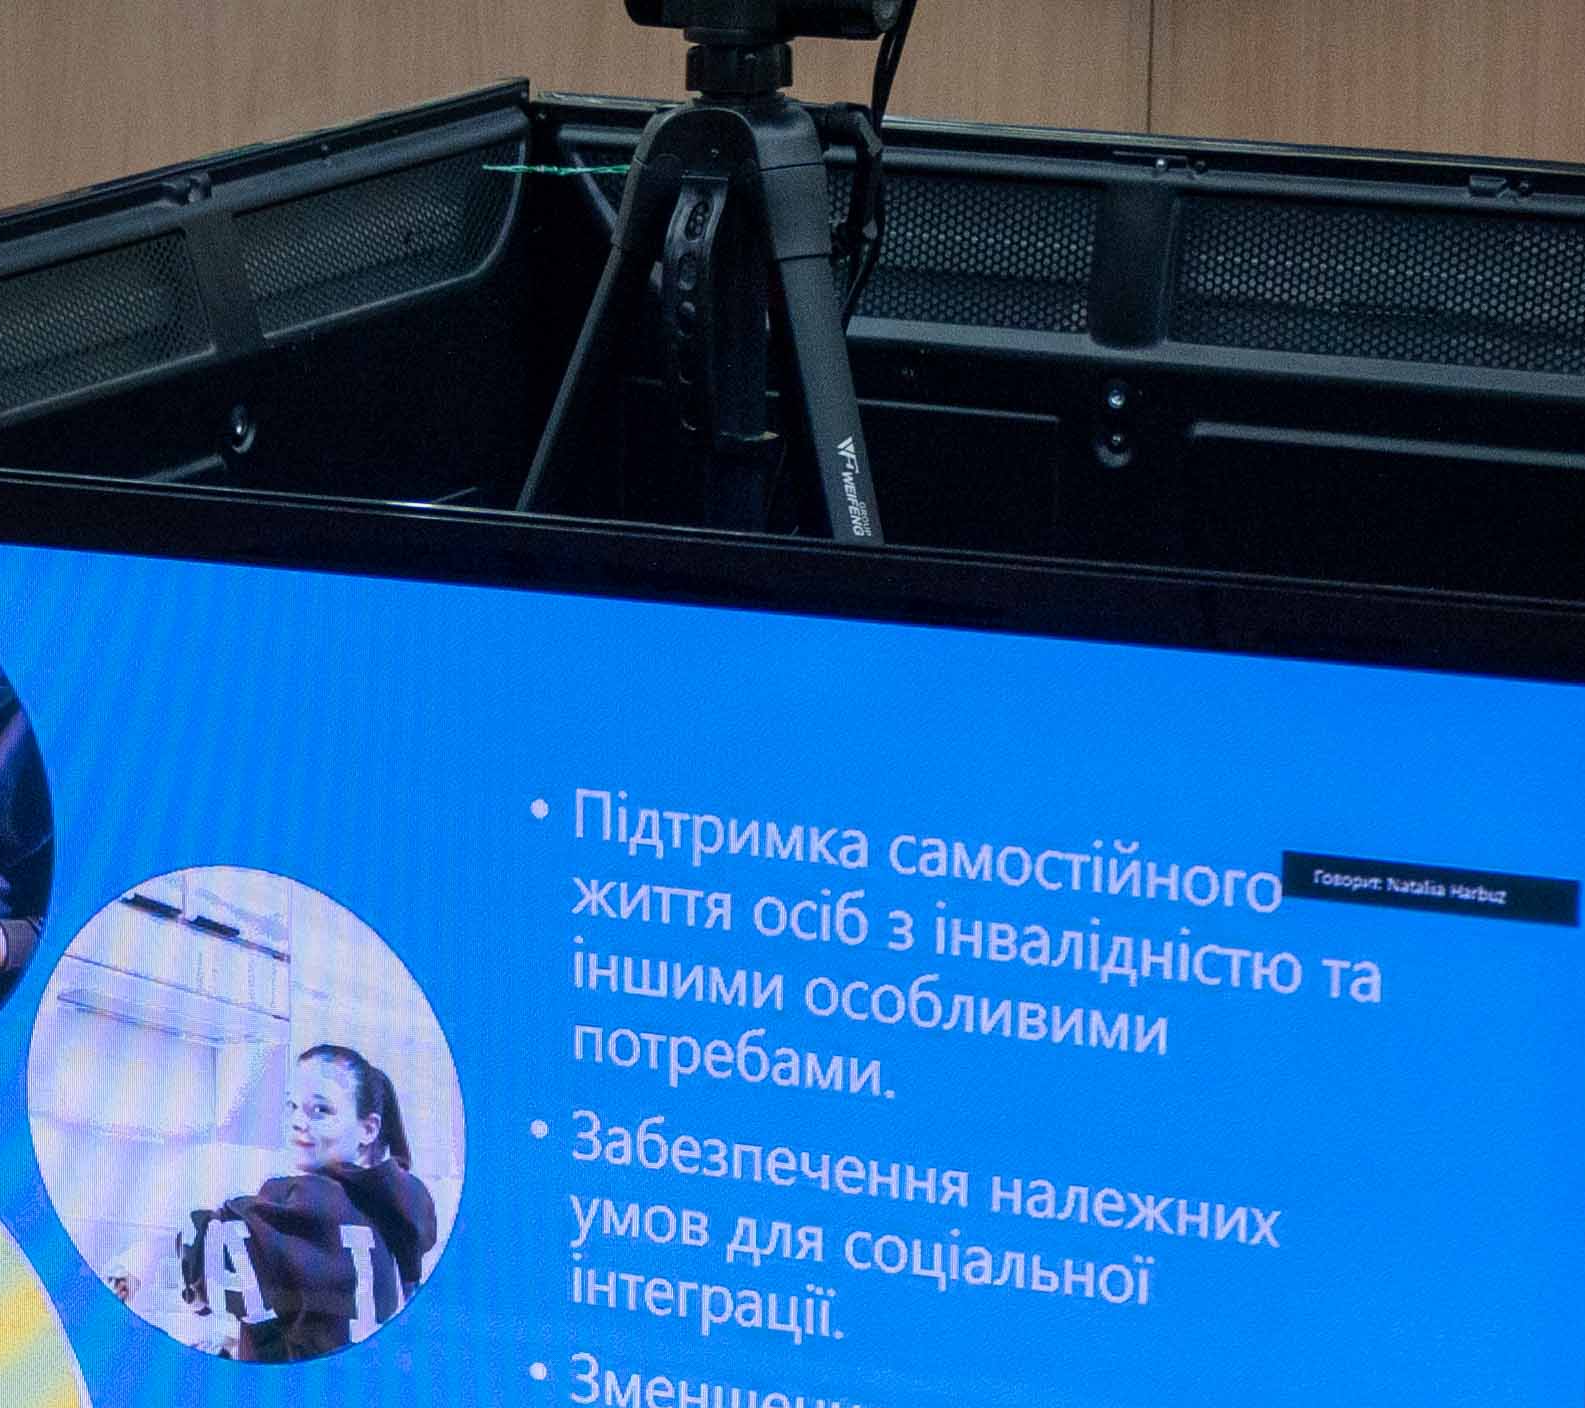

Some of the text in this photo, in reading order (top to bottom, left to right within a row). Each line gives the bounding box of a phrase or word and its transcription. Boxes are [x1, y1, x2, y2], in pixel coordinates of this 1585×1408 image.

[841, 472, 865, 537] WEIFENG
[859, 501, 872, 536] GROUP
[575, 788, 1284, 914] Підтримка самостійного
[1386, 876, 1446, 898] Natalia
[571, 876, 1383, 1004] життя осіб з інвалідністю та
[572, 936, 1168, 1056] іншими особливими
[573, 1023, 896, 1099] потребами.
[571, 1109, 1281, 1248] Забезпечення належних
[569, 1194, 1156, 1305] умов для соціальної
[571, 1252, 845, 1345] інтеграції.
